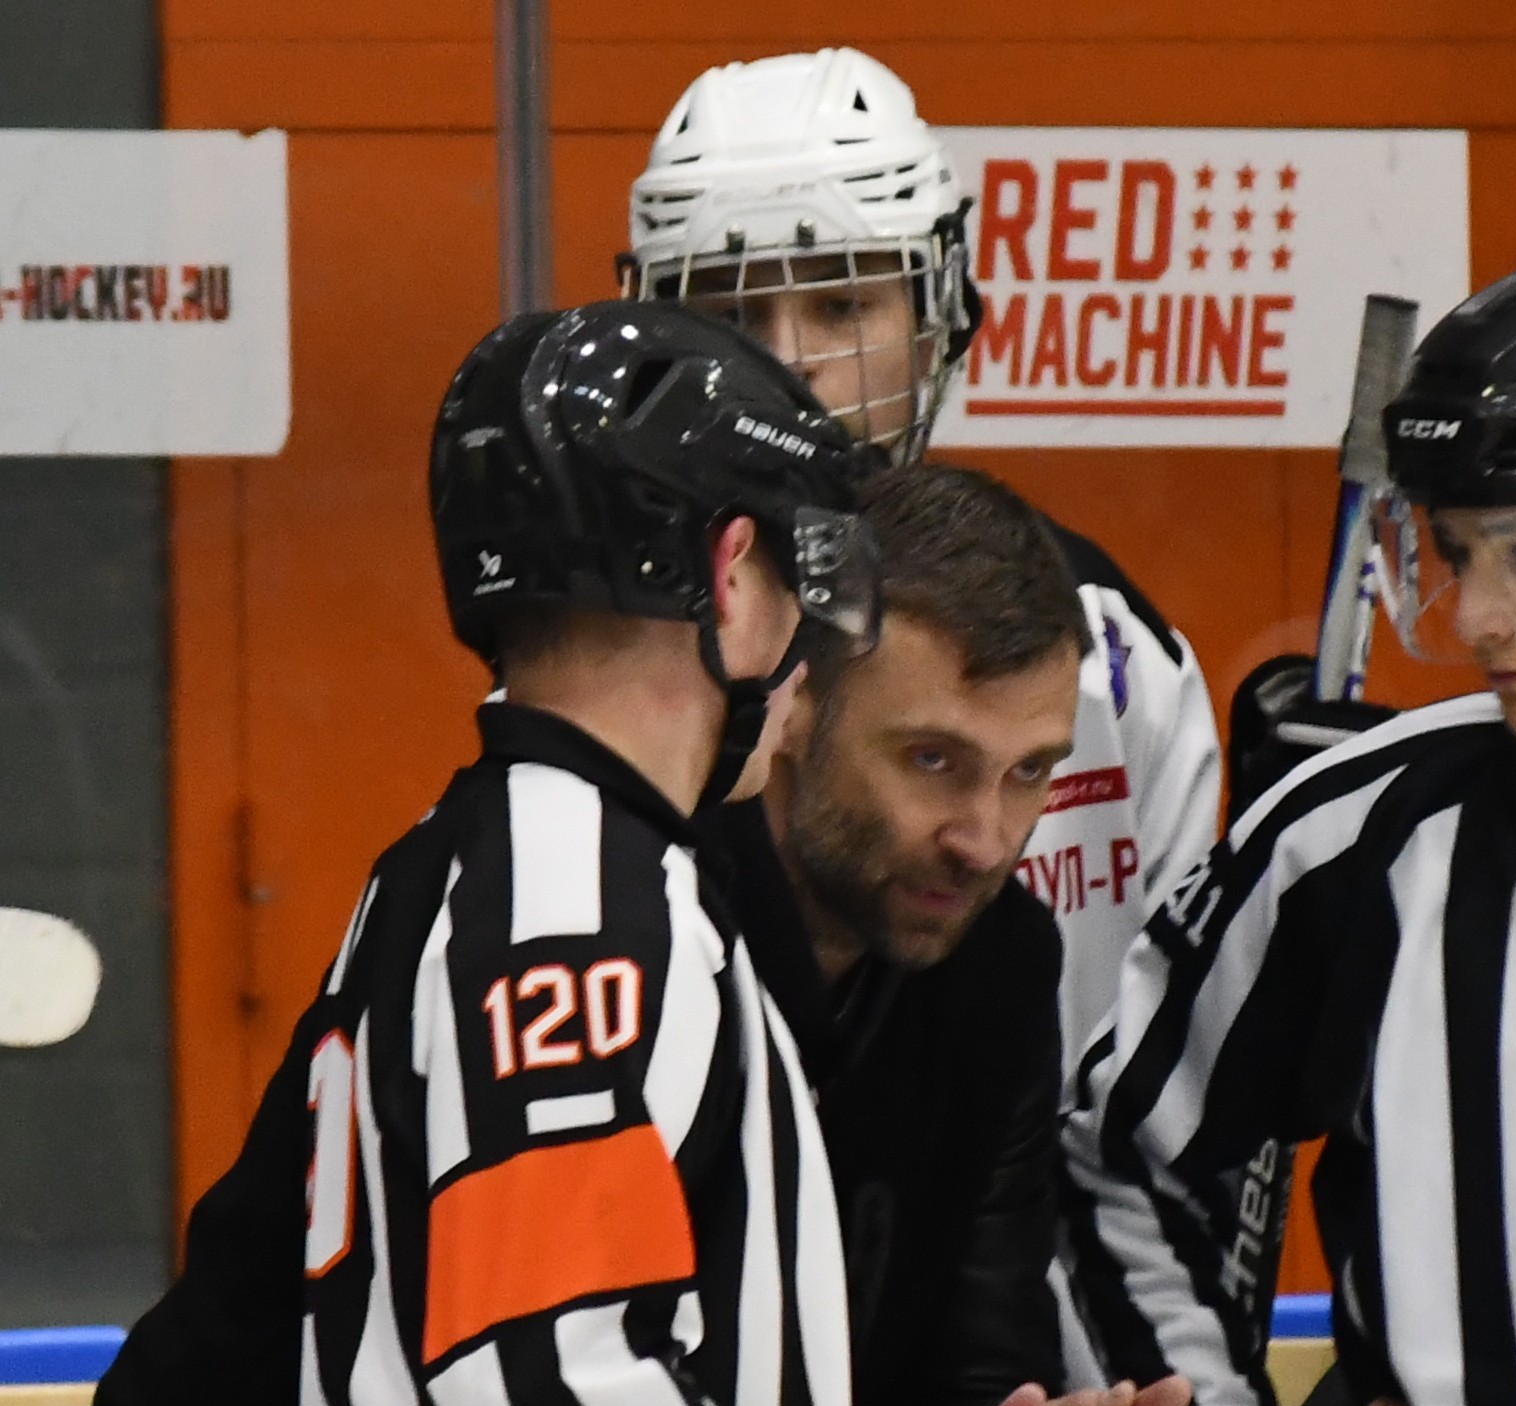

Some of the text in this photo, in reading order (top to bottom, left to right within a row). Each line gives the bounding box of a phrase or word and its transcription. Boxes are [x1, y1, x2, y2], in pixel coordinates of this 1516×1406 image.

[976, 159, 1175, 281] RED
[0, 264, 230, 321] -HOCKEY.RU
[966, 293, 1295, 388] MACHINE
[734, 416, 817, 460] BAUER
[1398, 418, 1462, 439] CCM
[481, 955, 643, 1081] 120
